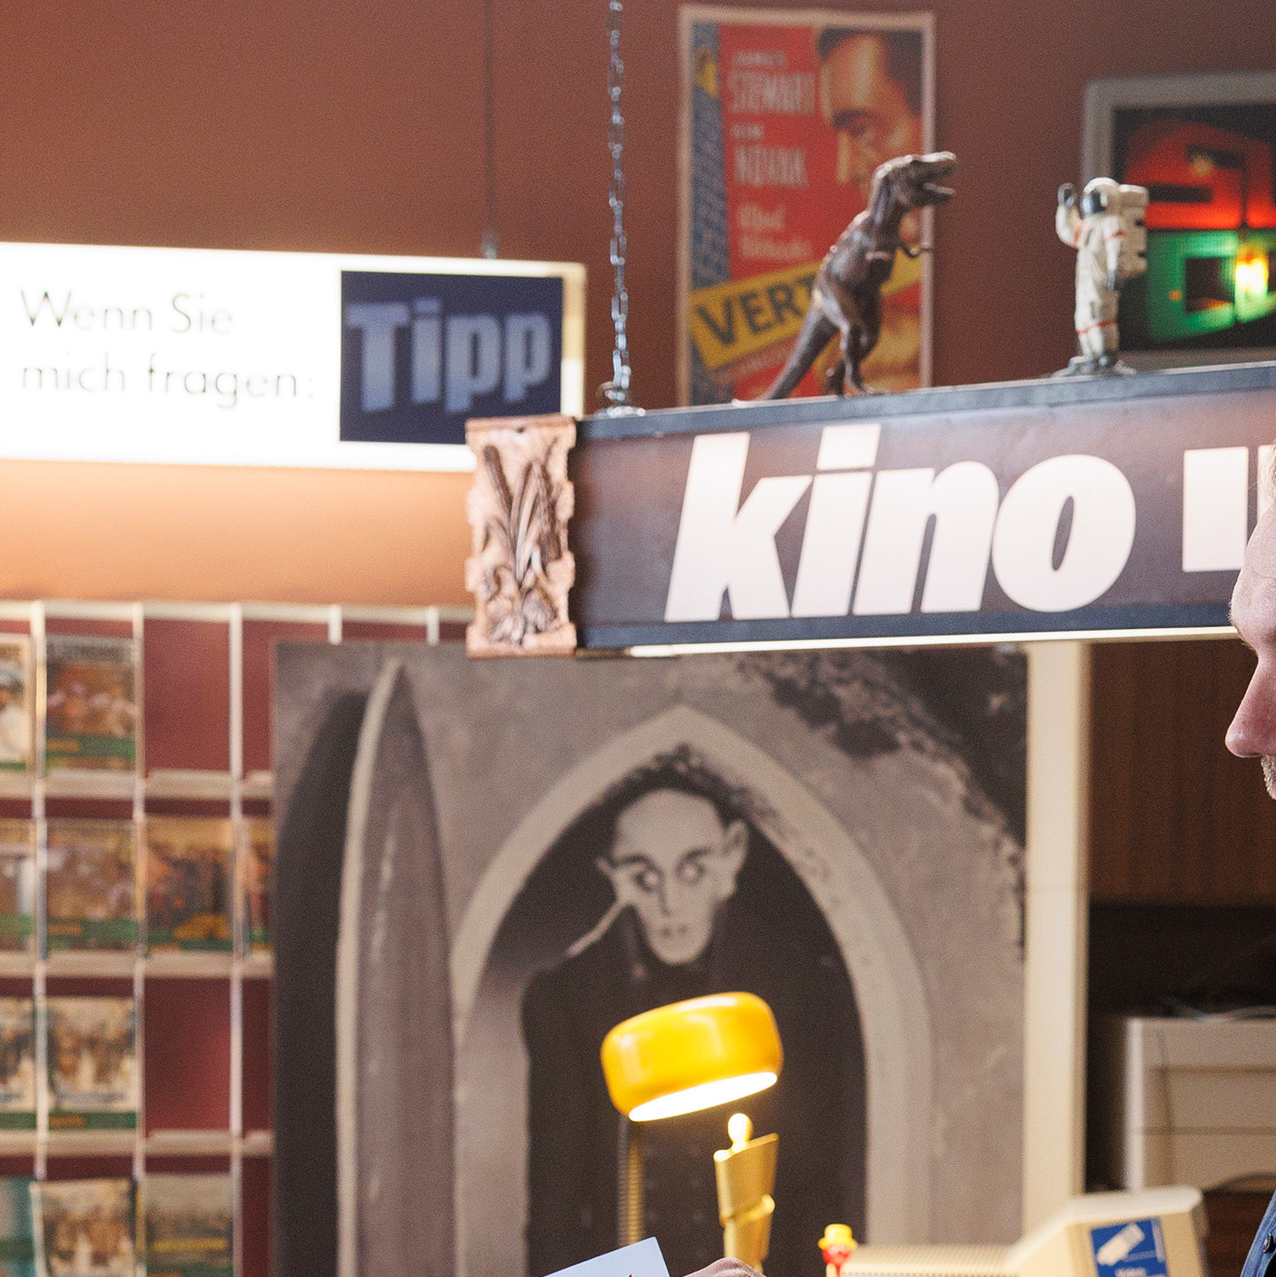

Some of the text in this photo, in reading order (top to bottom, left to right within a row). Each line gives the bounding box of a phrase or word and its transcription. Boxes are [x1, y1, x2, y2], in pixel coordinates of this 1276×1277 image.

[20, 287, 235, 335] Wenn Sie
[696, 275, 817, 347] VERT
[21, 352, 119, 393] mich
[346, 297, 552, 413] Tipp
[665, 423, 1136, 622] kino
